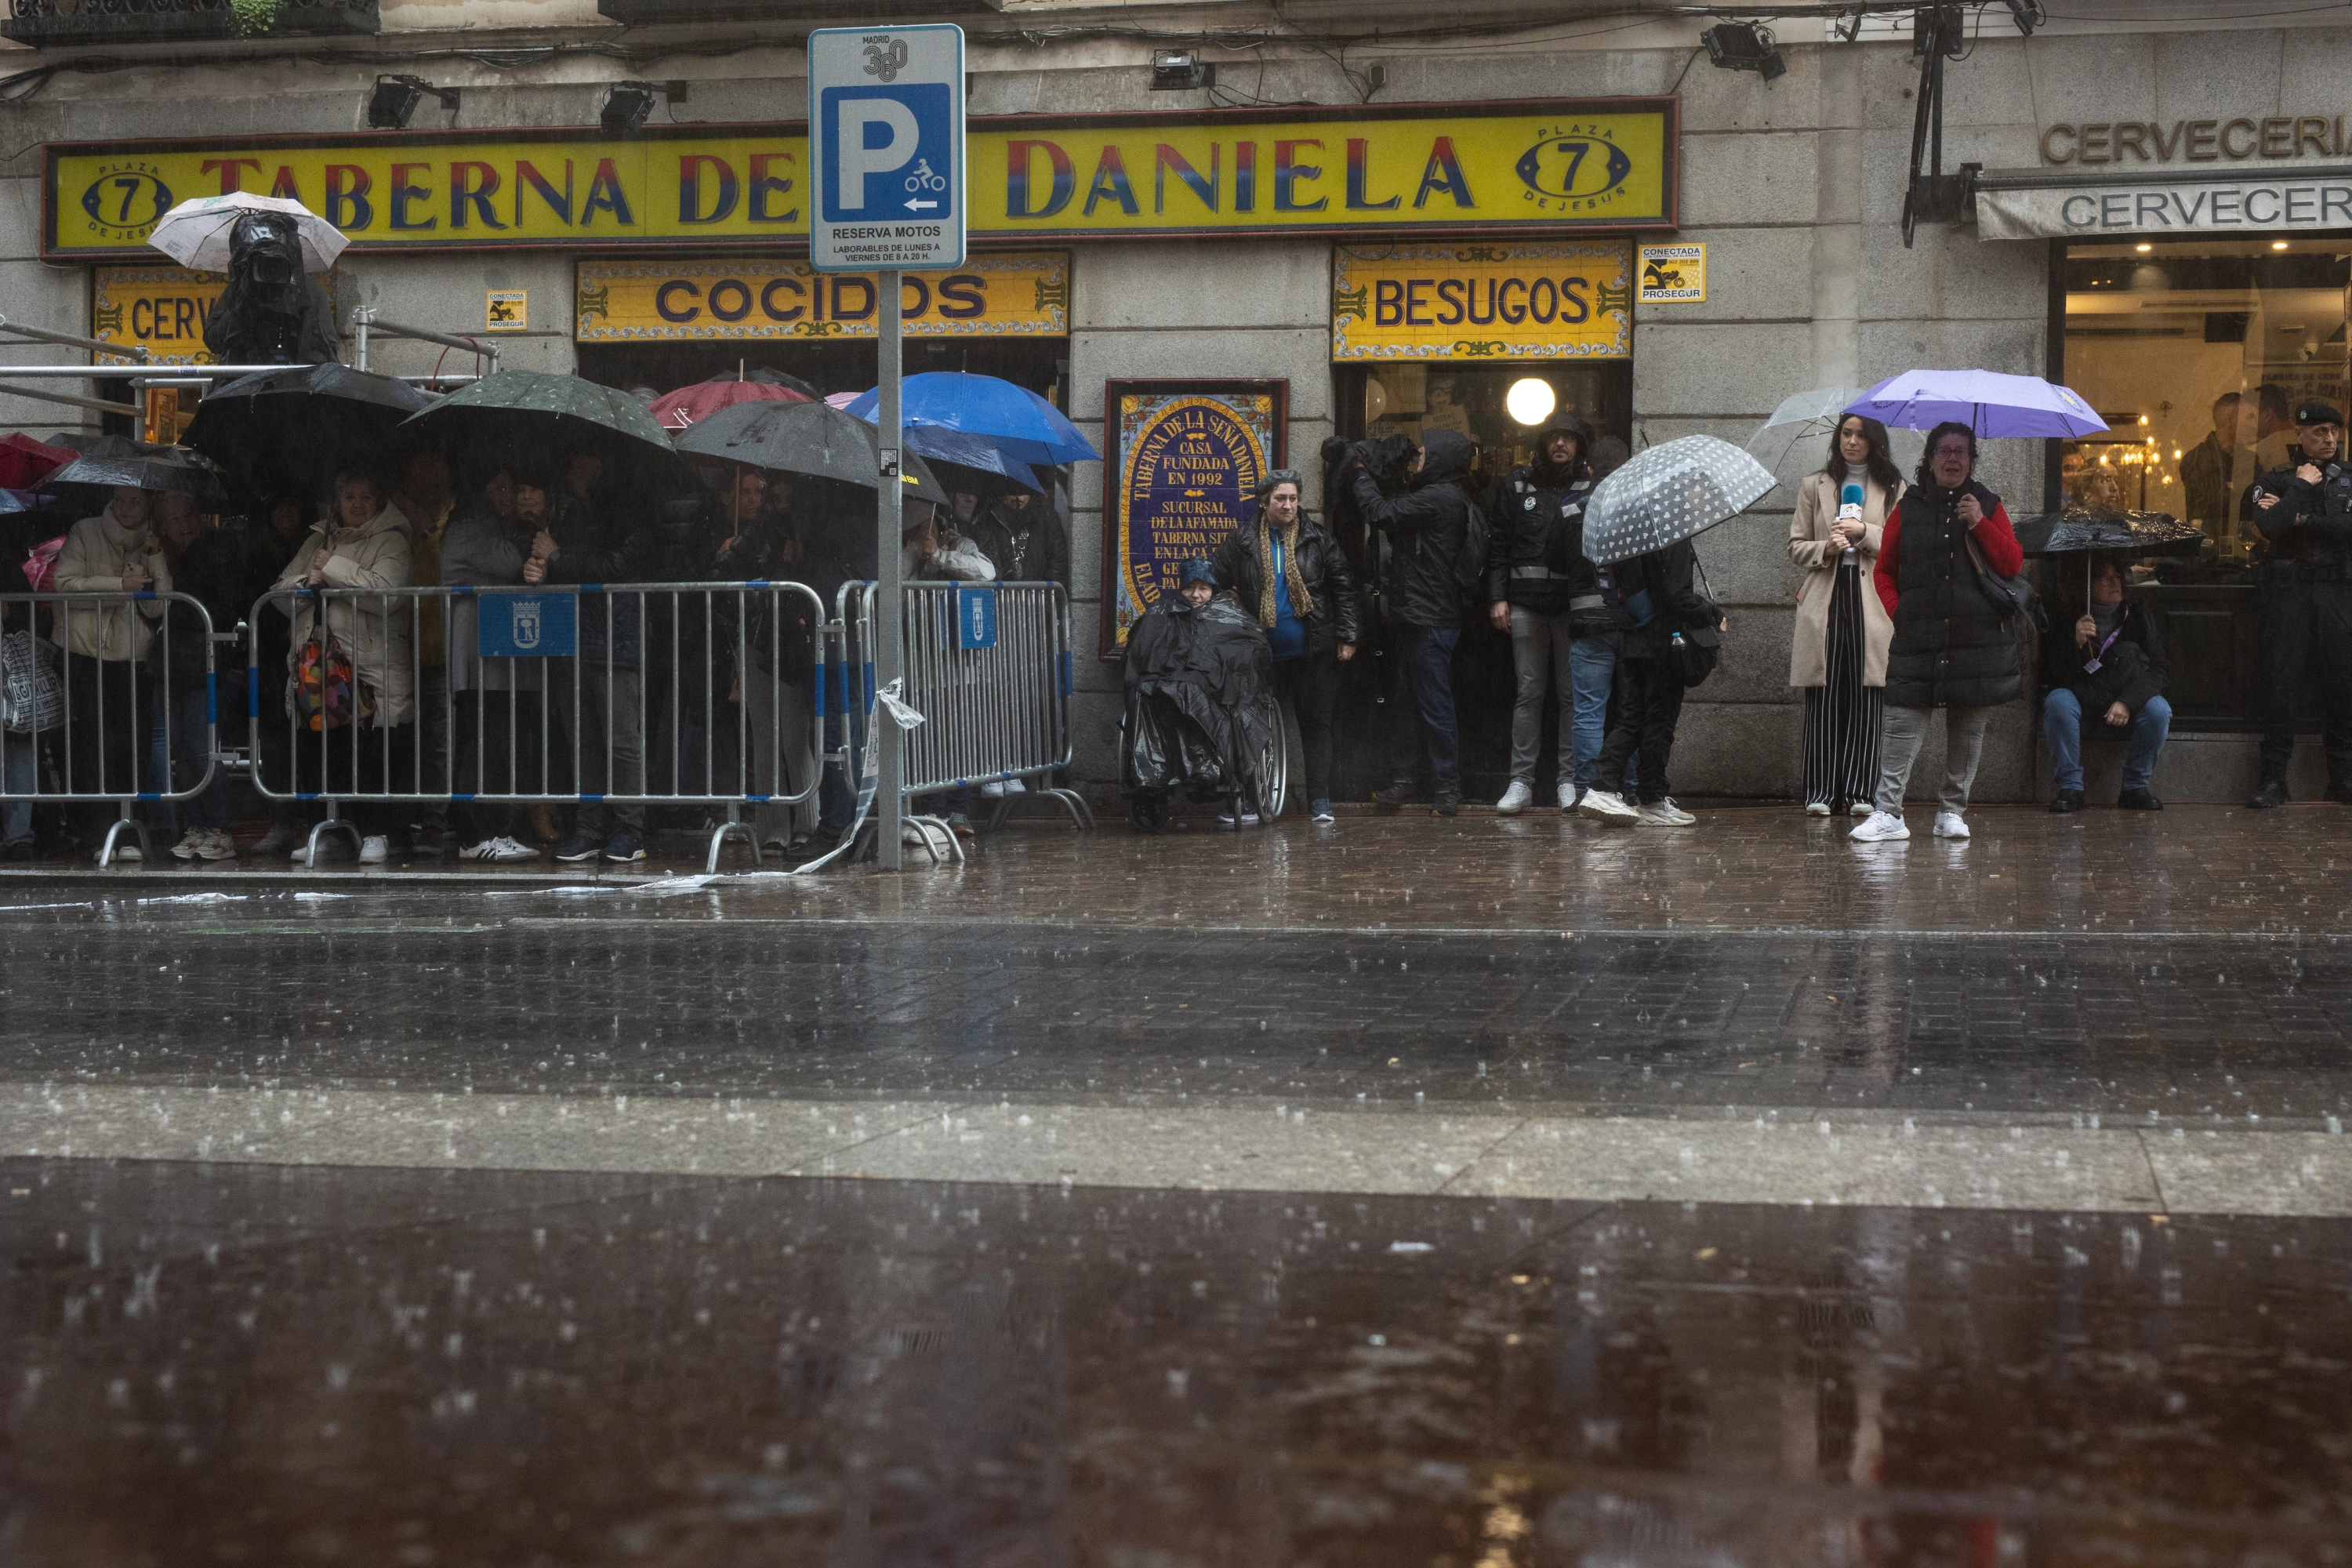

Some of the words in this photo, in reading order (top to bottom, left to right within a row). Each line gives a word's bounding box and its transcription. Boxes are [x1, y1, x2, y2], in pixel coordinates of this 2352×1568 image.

[862, 35, 890, 44] MADRID
[863, 39, 908, 82] 360
[1537, 124, 1613, 140] PLAZA
[2042, 115, 2352, 162] CERVECERI
[838, 98, 920, 210] P
[99, 162, 158, 175] PLAZA
[1557, 143, 1589, 191] 7
[201, 157, 634, 230] TABERNA
[678, 152, 800, 225] DE
[1004, 136, 1476, 220] DANIELA
[114, 178, 140, 222] 7
[1523, 191, 1548, 208] DE
[1558, 187, 1625, 211] JESUS
[2061, 186, 2352, 228] CERVECER
[88, 221, 107, 237] DE
[833, 227, 891, 239] RESERVA
[895, 226, 941, 238] MOTOS
[833, 245, 889, 253] LABORABLES
[655, 275, 987, 323] COCIDOS
[1642, 289, 1700, 298] PROSEGUR
[1374, 277, 1591, 327] BESUGOS
[1179, 441, 1213, 455] CASA
[1134, 434, 1171, 501] TABERNA
[1163, 416, 1185, 439] DE
[1185, 411, 1205, 429] LA
[1230, 444, 1255, 503] DANIELA
[1163, 457, 1230, 470] FUNDADA
[1167, 472, 1186, 485] EN
[1191, 472, 1223, 485] 1992
[1162, 501, 1227, 515] SUCURSAL
[1151, 517, 1167, 529] DE
[1169, 517, 1184, 528] LA
[1185, 517, 1239, 529] AFAMADA
[1152, 532, 1206, 546] TABERNA
[1154, 546, 1172, 559] EN
[1173, 546, 1189, 559] LA
